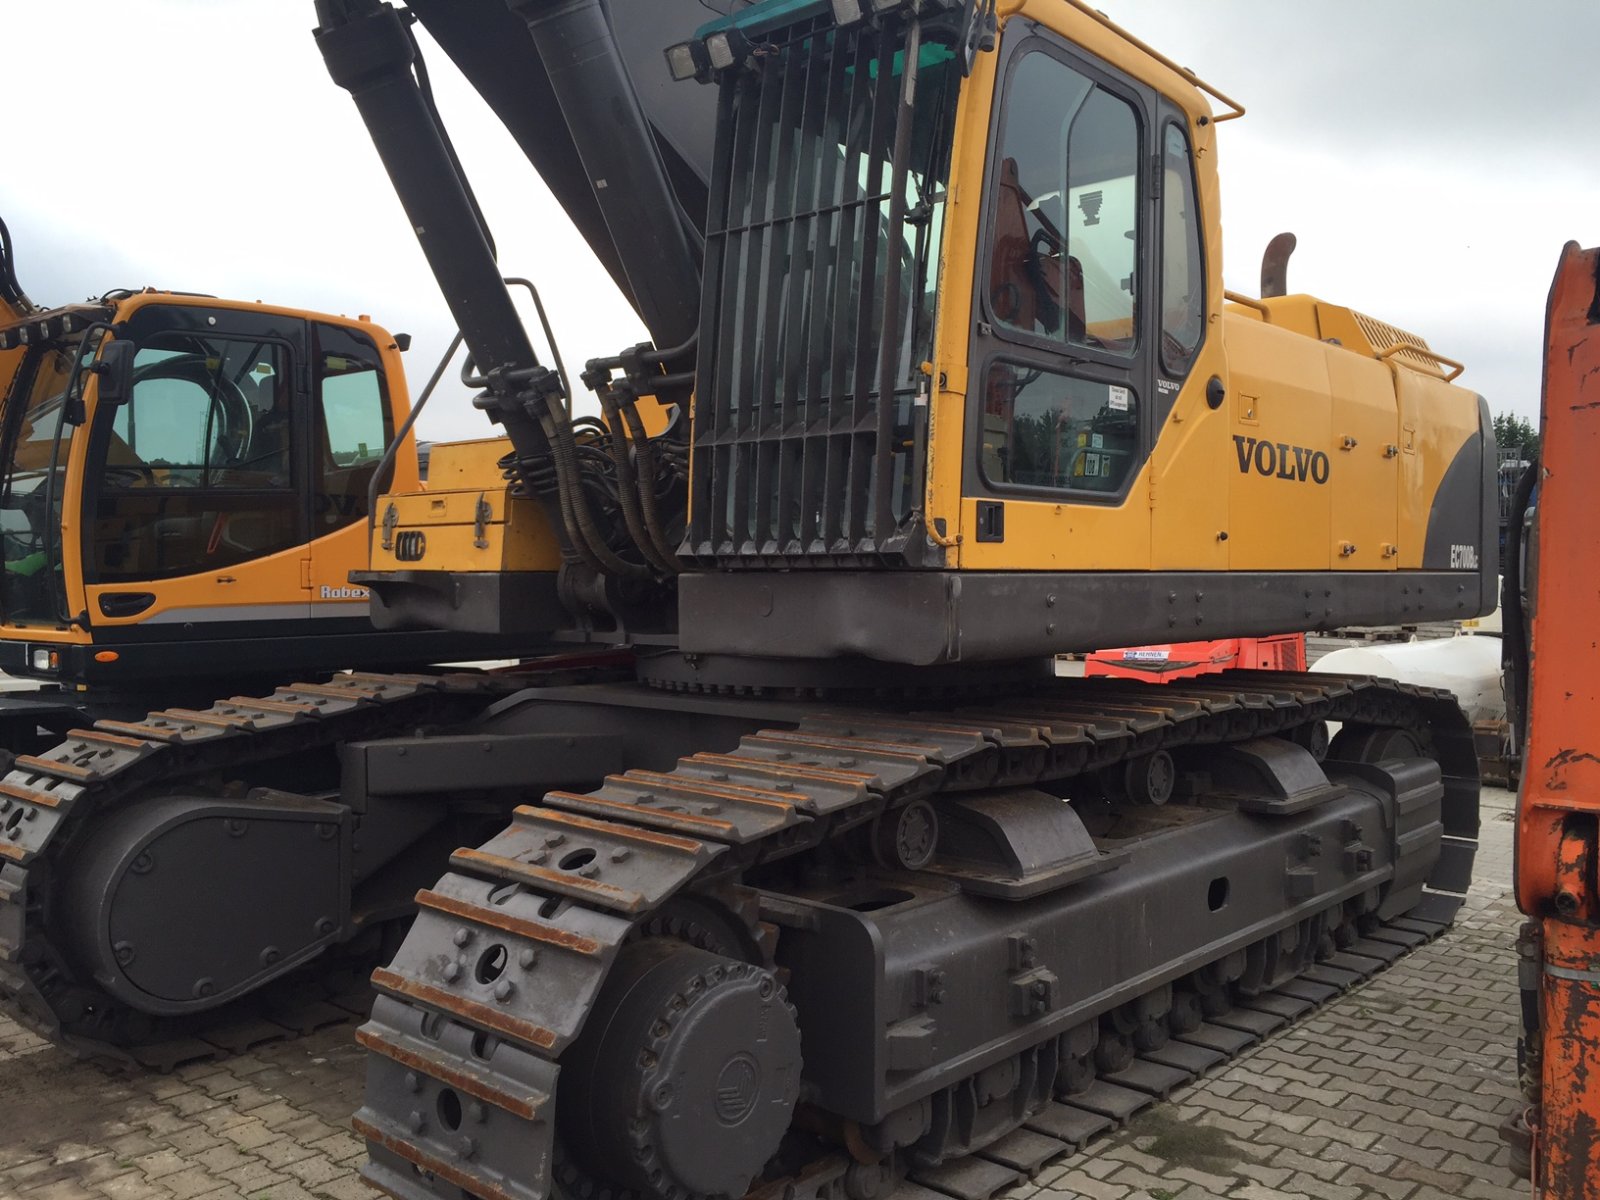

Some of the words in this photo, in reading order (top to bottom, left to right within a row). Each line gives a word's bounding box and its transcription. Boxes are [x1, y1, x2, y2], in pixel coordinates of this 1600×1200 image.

[1157, 379, 1180, 391] VOLVO
[1232, 434, 1330, 485] VOLVO
[320, 585, 370, 598] Robex
